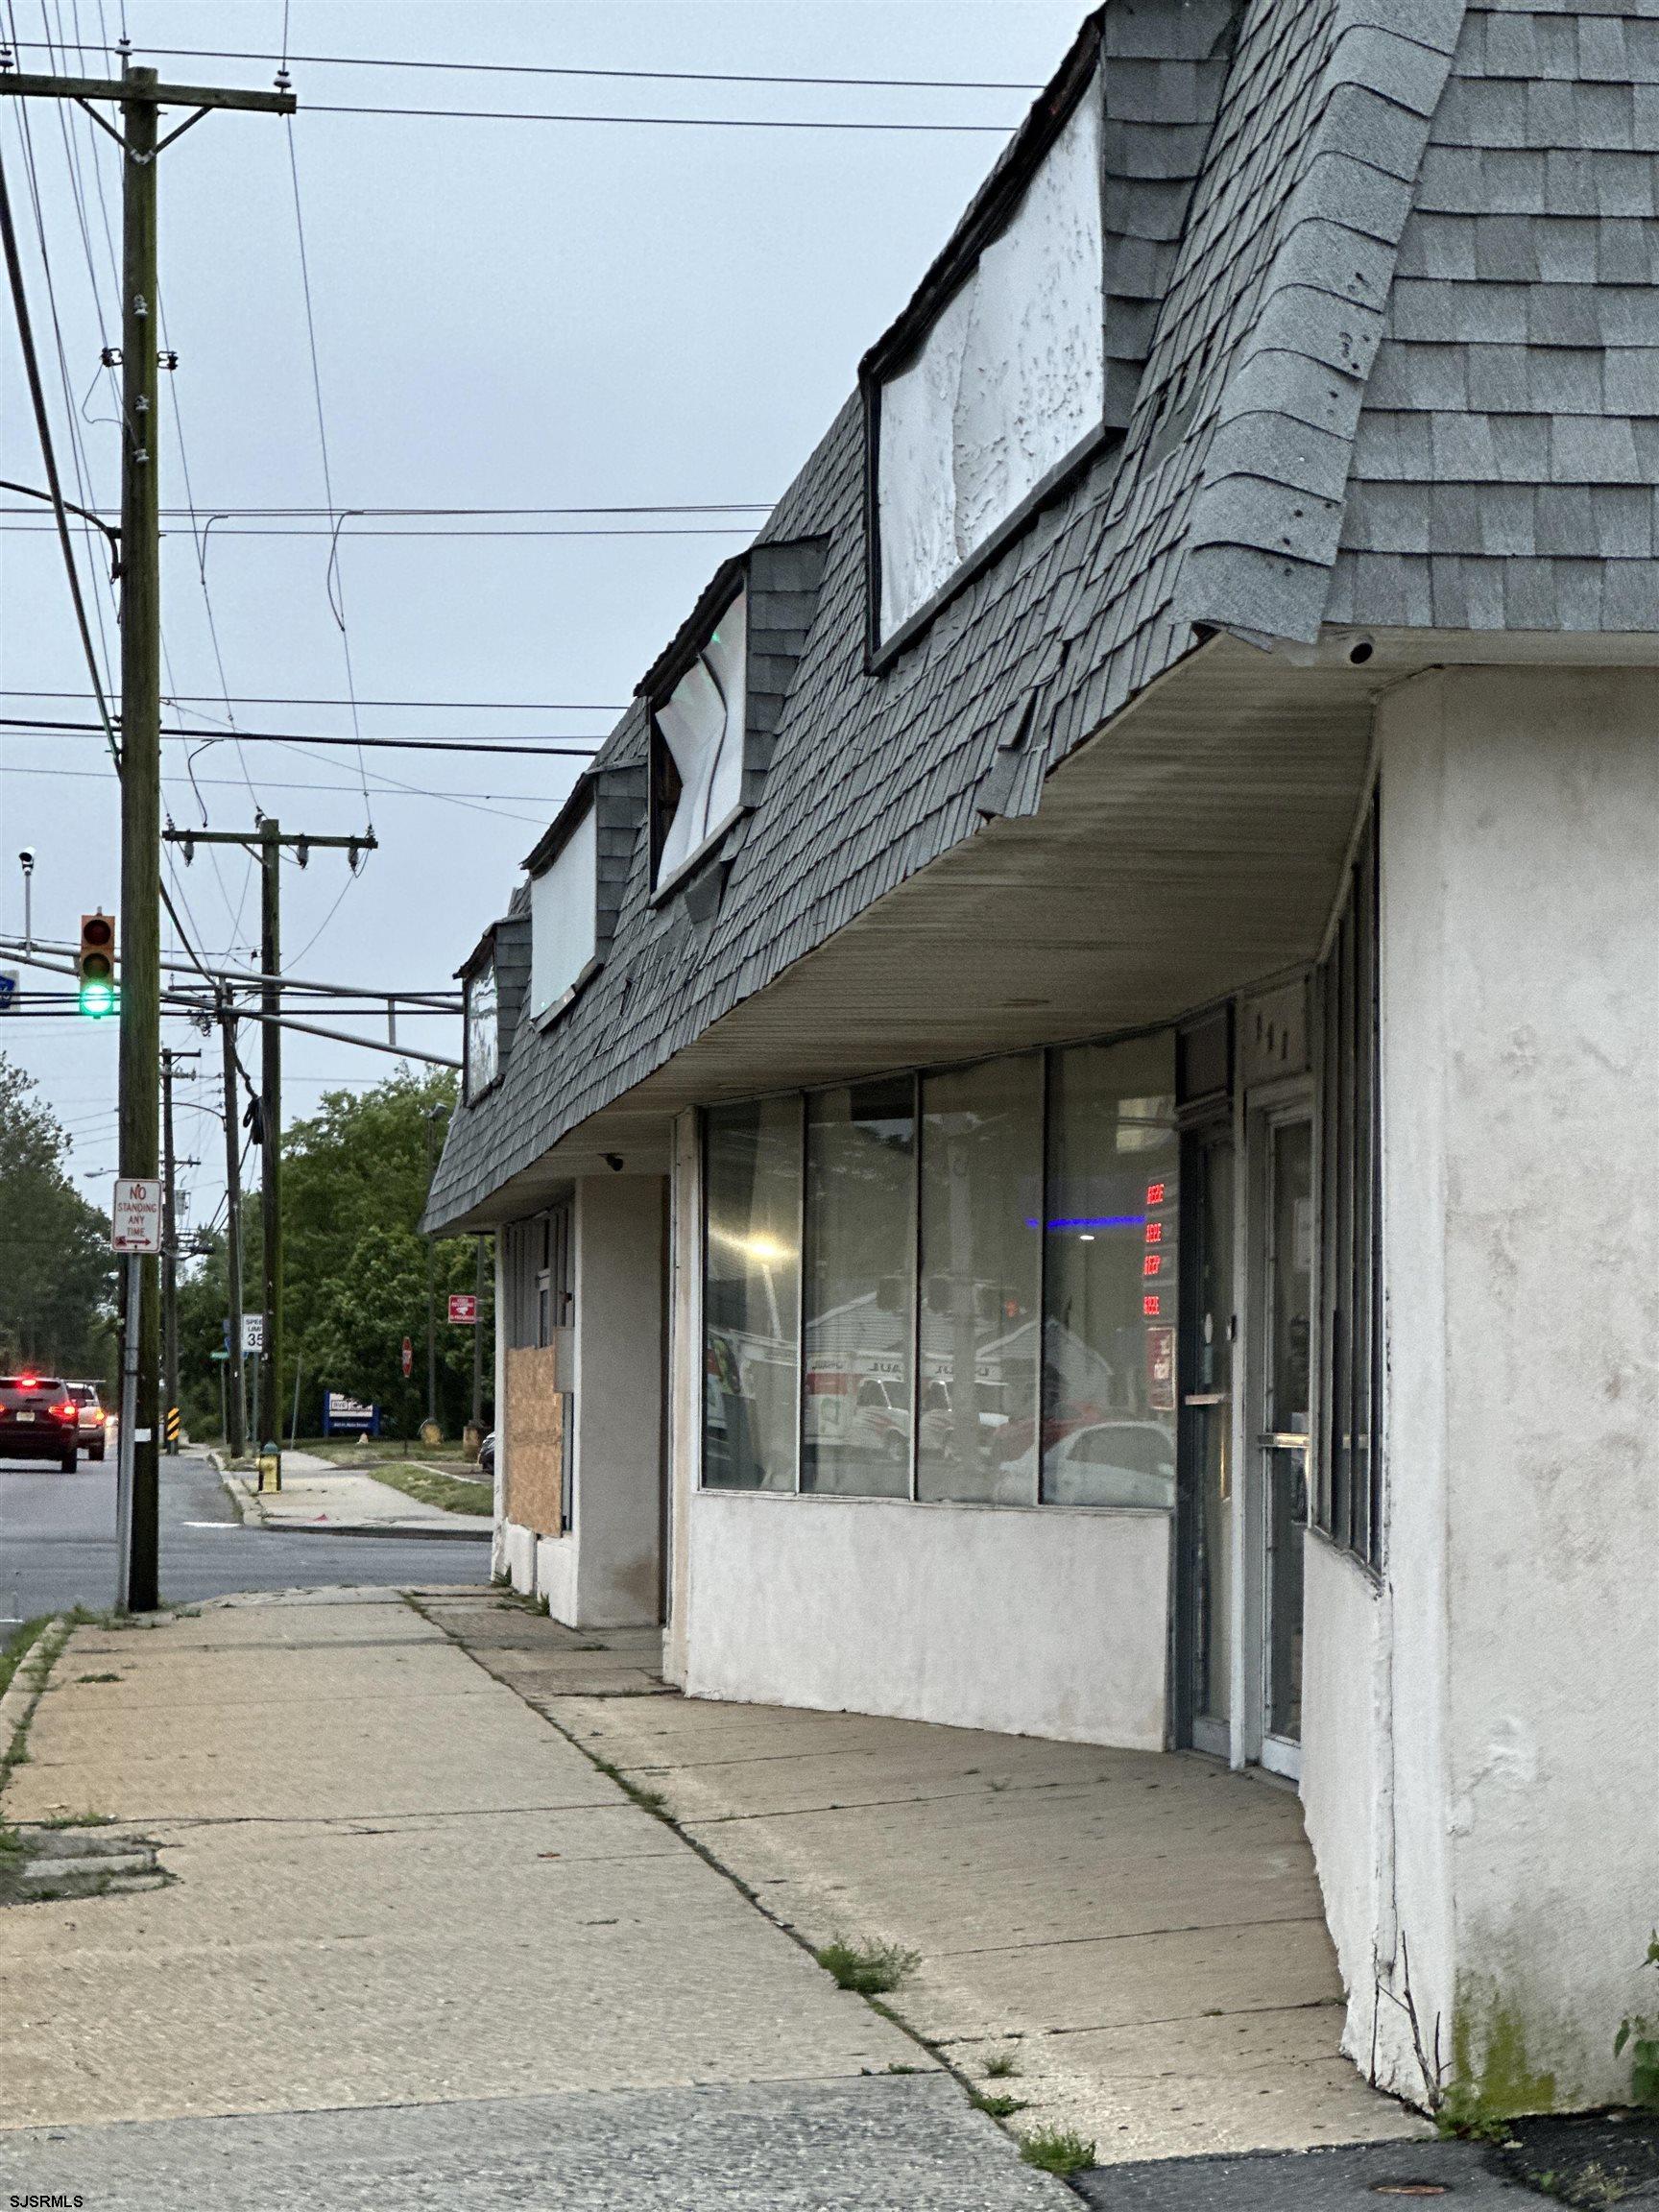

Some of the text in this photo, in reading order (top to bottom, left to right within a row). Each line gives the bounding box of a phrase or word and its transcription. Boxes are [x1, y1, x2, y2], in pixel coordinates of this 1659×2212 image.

[130, 1187, 147, 1200] NO
[117, 1202, 157, 1213] STANDING
[128, 1215, 145, 1224] ANY
[127, 1227, 145, 1237] TIME
[248, 1333, 263, 1346] 35
